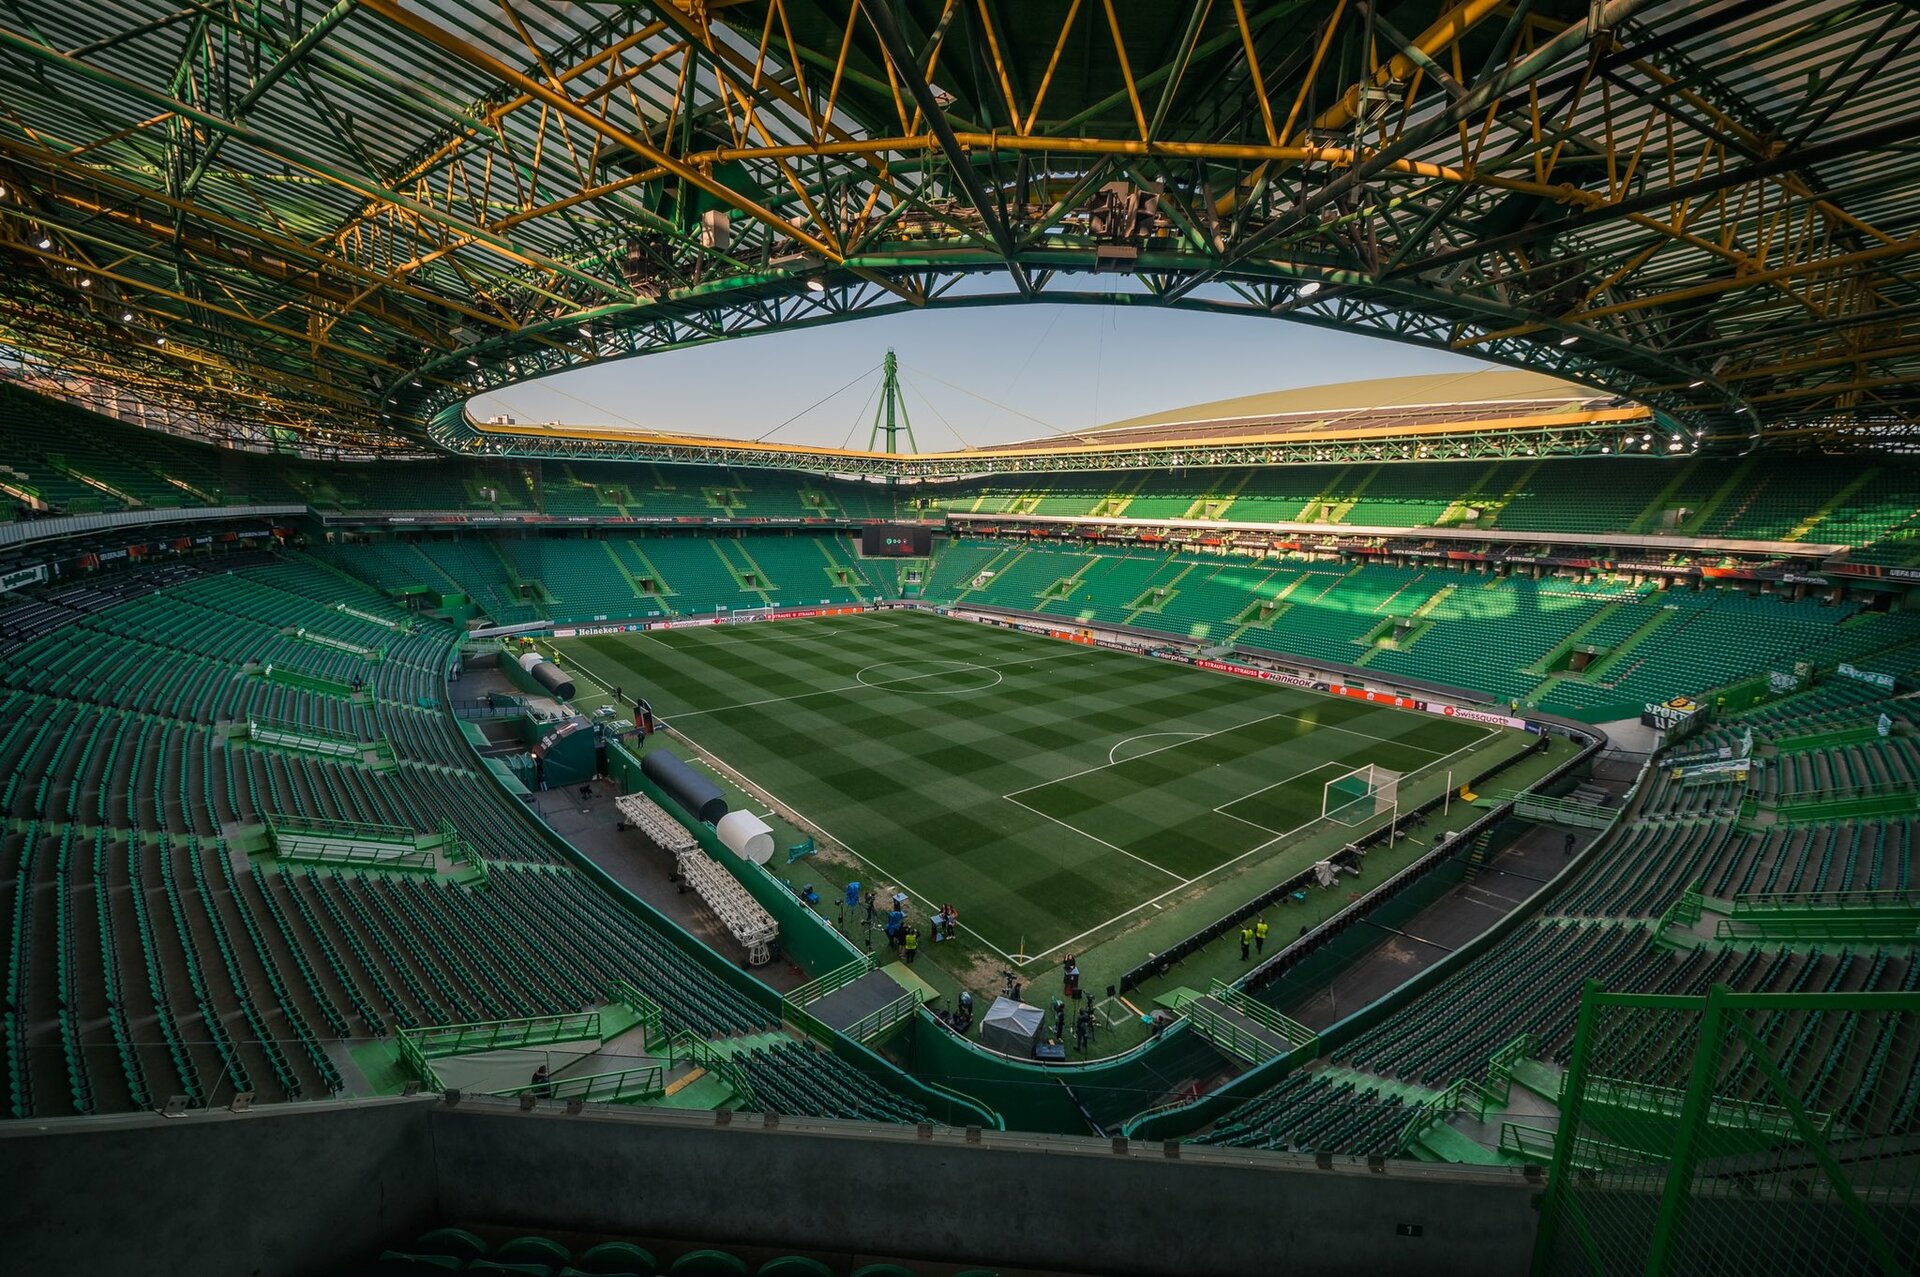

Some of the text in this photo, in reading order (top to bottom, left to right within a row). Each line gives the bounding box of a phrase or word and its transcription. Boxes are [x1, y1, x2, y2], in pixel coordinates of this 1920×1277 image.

[1890, 569, 1909, 577] UEFA
[578, 627, 619, 636] Heineken
[1122, 645, 1138, 653] LEAGUE
[1151, 651, 1188, 663] enterprise
[1204, 661, 1258, 676] STRAUSS STRAUSS
[1455, 708, 1509, 726] Swissquote
